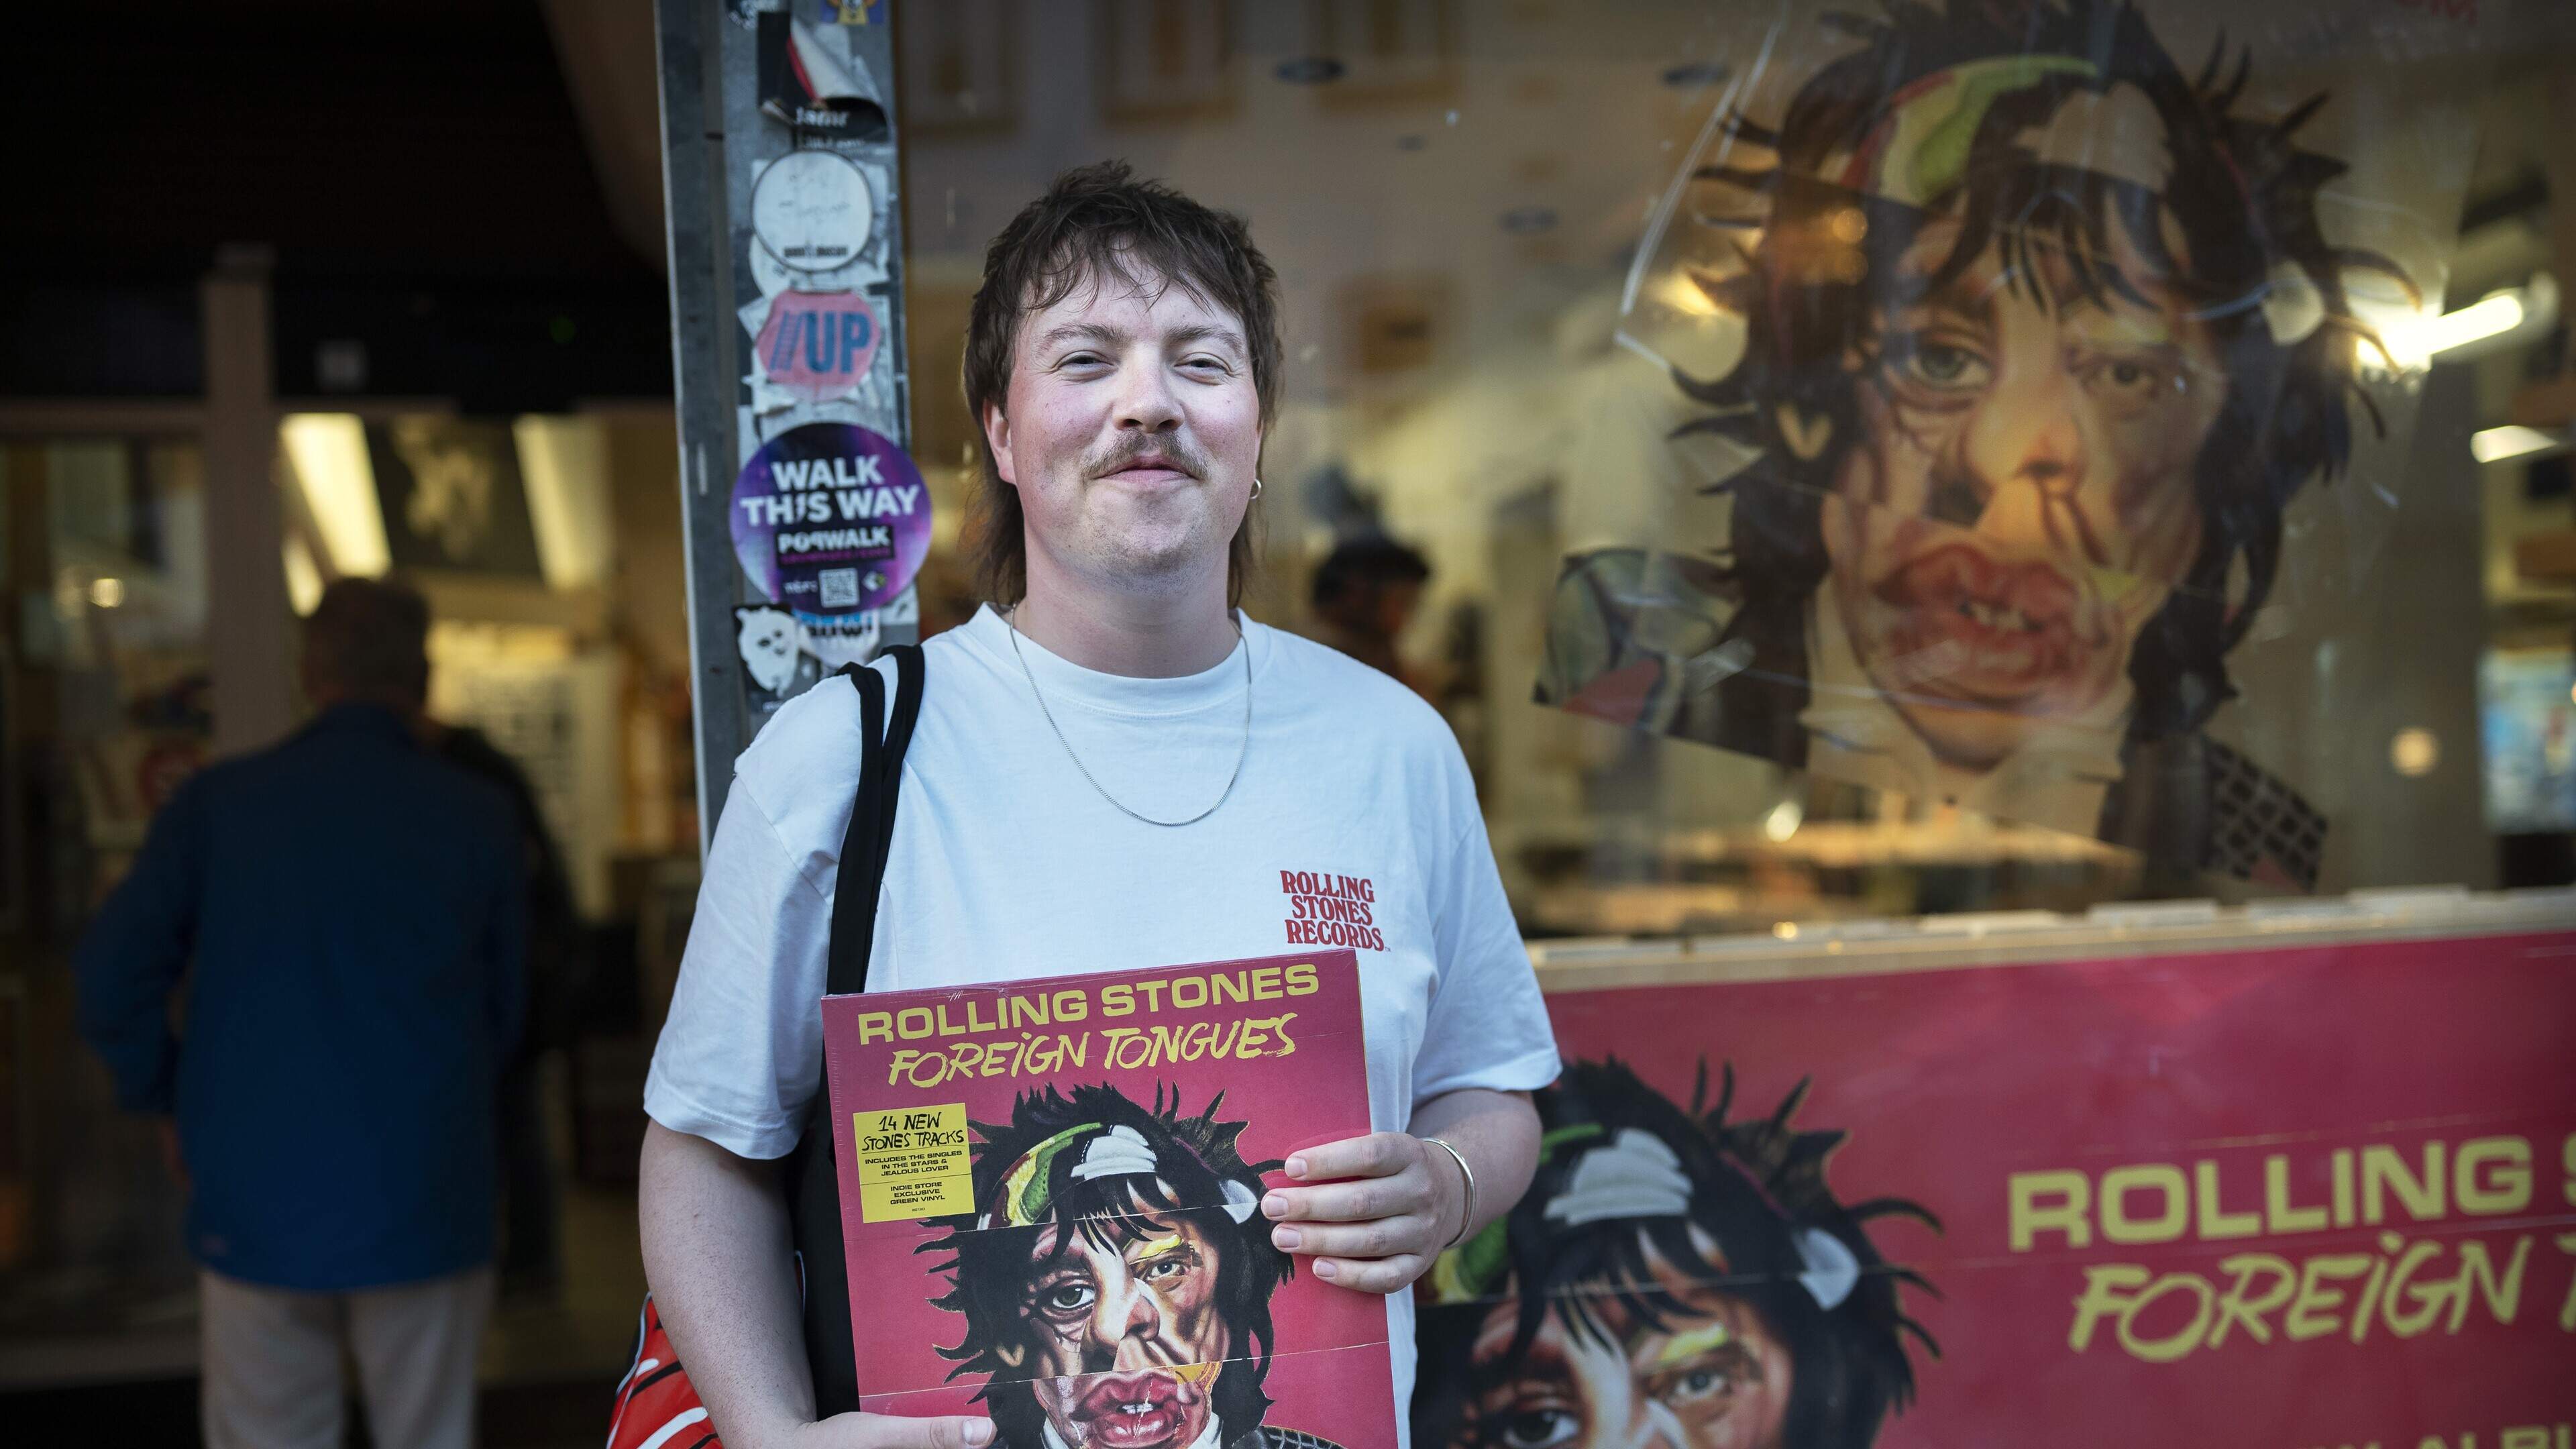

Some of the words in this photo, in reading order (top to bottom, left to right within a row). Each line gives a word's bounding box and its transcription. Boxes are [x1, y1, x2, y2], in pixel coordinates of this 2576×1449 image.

[771, 454, 885, 492] WALK
[739, 491, 832, 527] THIS
[836, 484, 920, 521] WAY
[1280, 870, 1375, 903] ROLLING
[1291, 895, 1373, 926] STONES
[1285, 919, 1385, 952] RECORDS
[859, 989, 1087, 1045] ROLLING
[1102, 963, 1320, 1017] STONES
[1101, 1013, 1298, 1072] TONGUES
[879, 1116, 897, 1132] 14
[904, 1112, 942, 1130] NEW
[862, 1132, 910, 1151] STONES
[914, 1130, 965, 1146] TRACKS
[865, 1156, 906, 1164] INCLUDES
[928, 1150, 962, 1159] SINGLES
[894, 1189, 940, 1197] EXCLUSIVE
[2008, 1136, 2533, 1252] ROLLING
